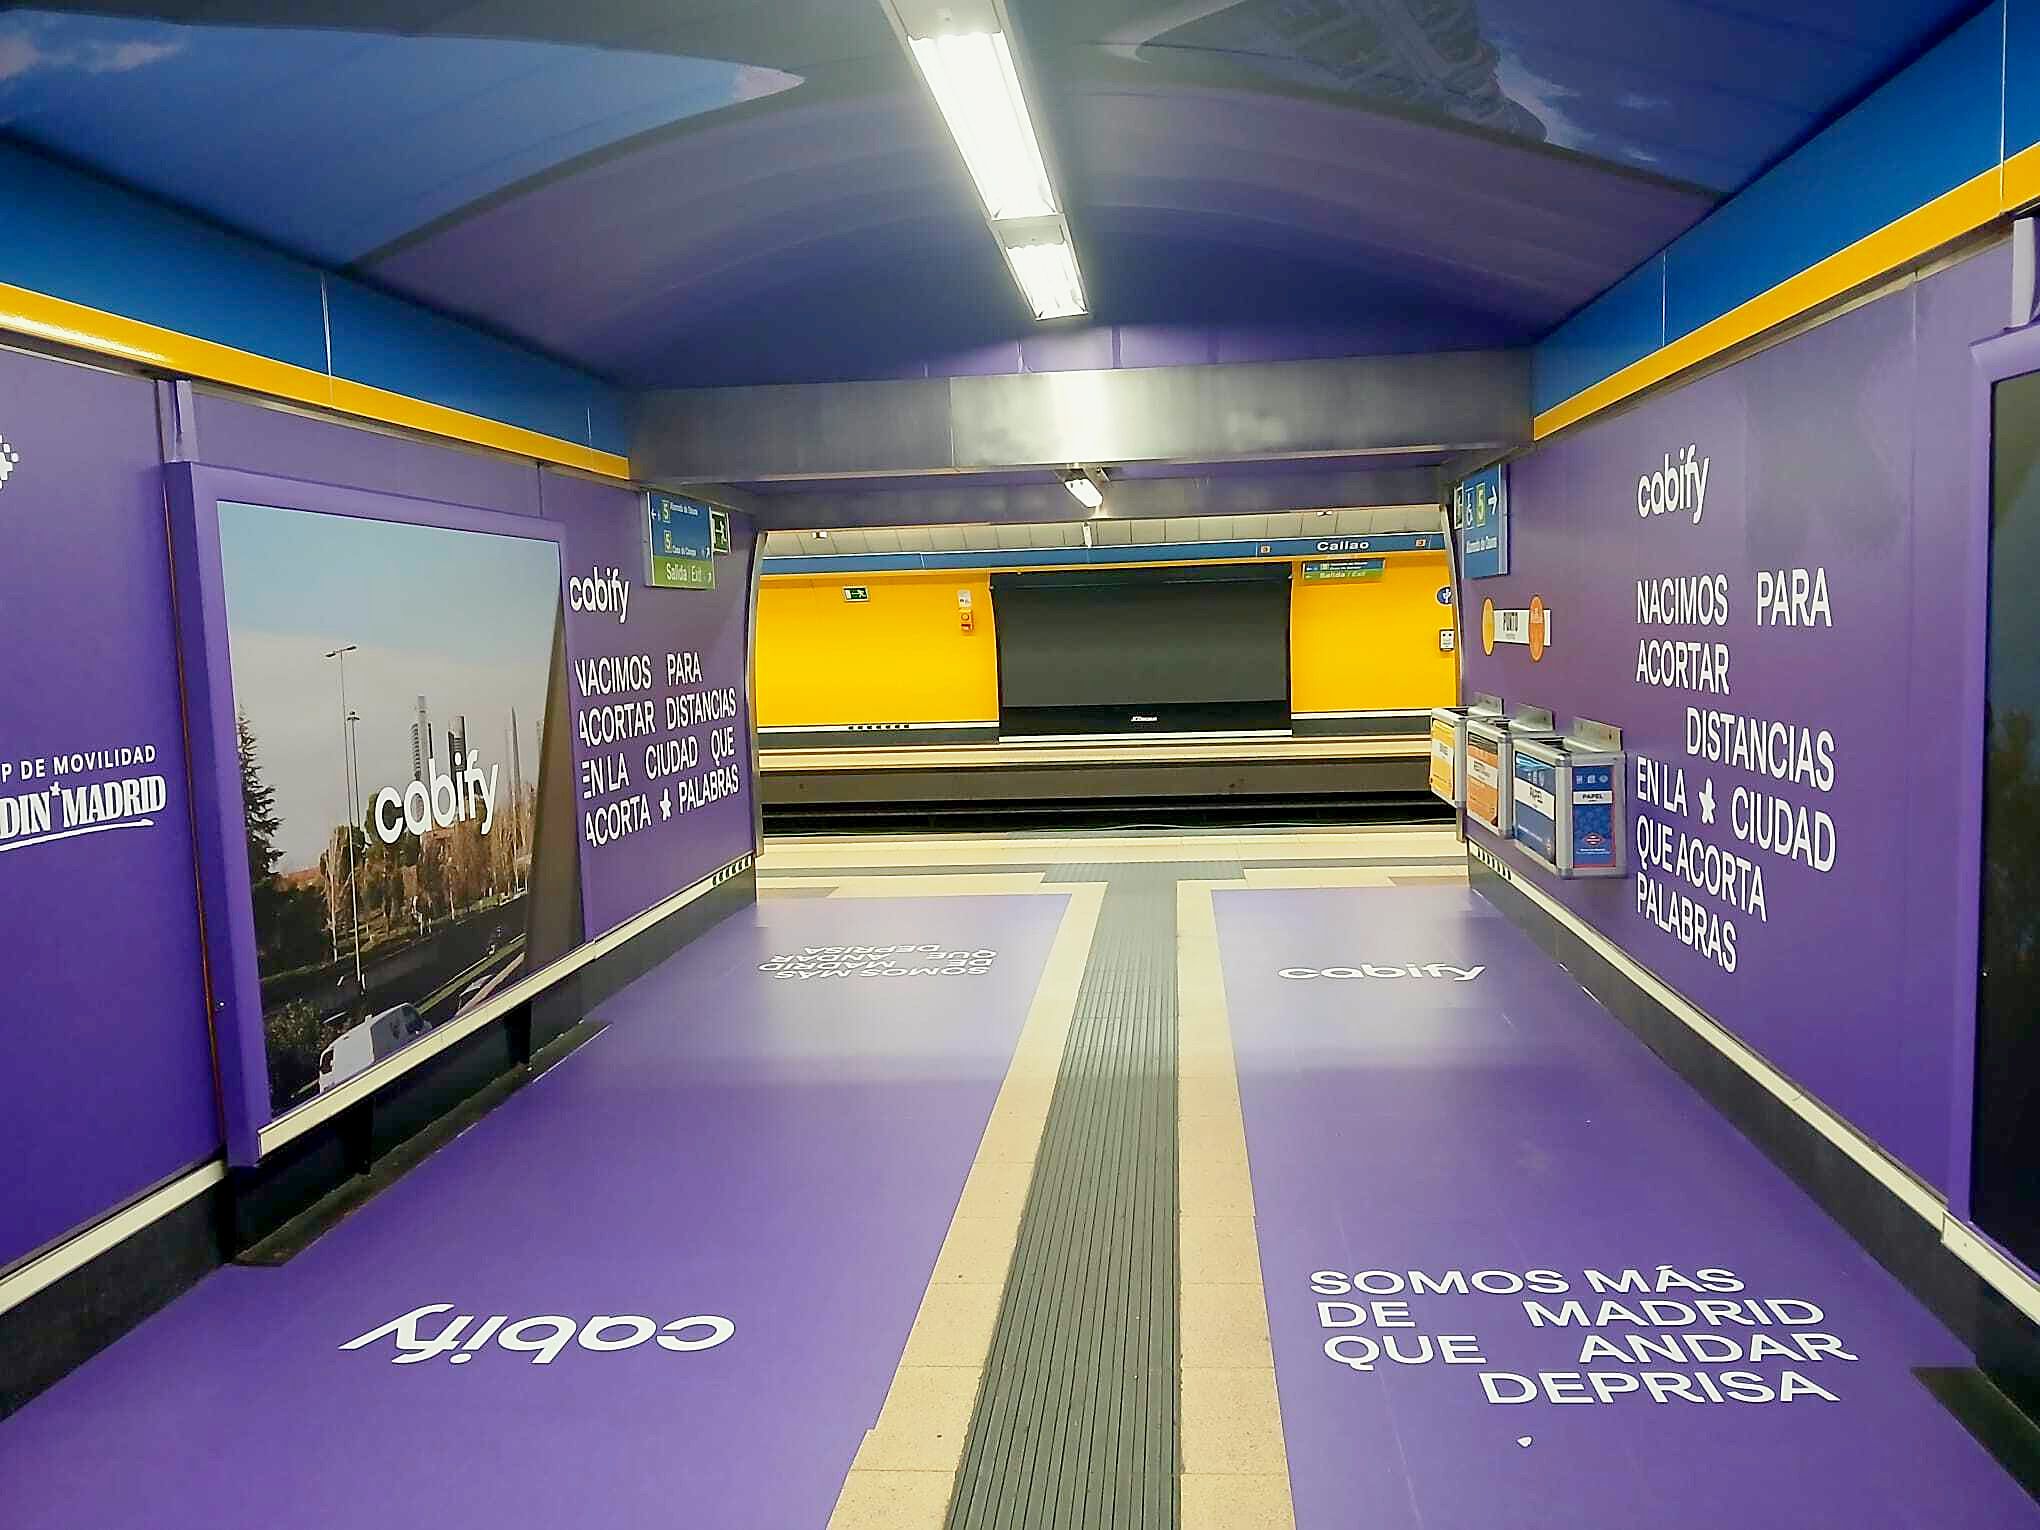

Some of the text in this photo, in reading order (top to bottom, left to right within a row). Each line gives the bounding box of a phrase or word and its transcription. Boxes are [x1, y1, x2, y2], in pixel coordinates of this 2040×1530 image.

[1637, 444, 1710, 524] cabify
[666, 562, 687, 581] Salida
[1317, 541, 1369, 550] Callao
[570, 566, 630, 624] cabify
[1636, 567, 1833, 627] NACIMOS PARA
[667, 651, 703, 687] PARA
[1636, 639, 1730, 695] ACORTAR
[579, 687, 737, 748] ACORTAR DISTANCIAS
[20, 758, 46, 781] DE
[53, 745, 157, 775] MOVILIDAD
[608, 752, 630, 792] LA
[645, 735, 699, 781] CIUDAD
[710, 726, 736, 767] QUE
[1686, 705, 1836, 792] DISTANCIAS
[61, 775, 167, 828] MADRID
[374, 748, 499, 846] cabify
[584, 763, 739, 848] ACORTA PALABRAS
[1636, 755, 1836, 873] EN LA CIUDAD
[1636, 814, 1768, 923] QUE ACORTA
[803, 944, 941, 954] DEPRISA
[1636, 872, 1738, 974] PALABRAS
[758, 961, 897, 971] MADRID
[770, 950, 997, 963] QUE ANDAR
[859, 966, 988, 977] SOMOS
[1277, 963, 1486, 982] cabify
[1309, 1265, 1745, 1295] SOMOS MÁS
[338, 1303, 736, 1364] cabify
[1317, 1299, 1825, 1329] DE MADRID
[1323, 1333, 1859, 1372] QUE ANDAR
[1478, 1370, 1841, 1405] DEPRISA
